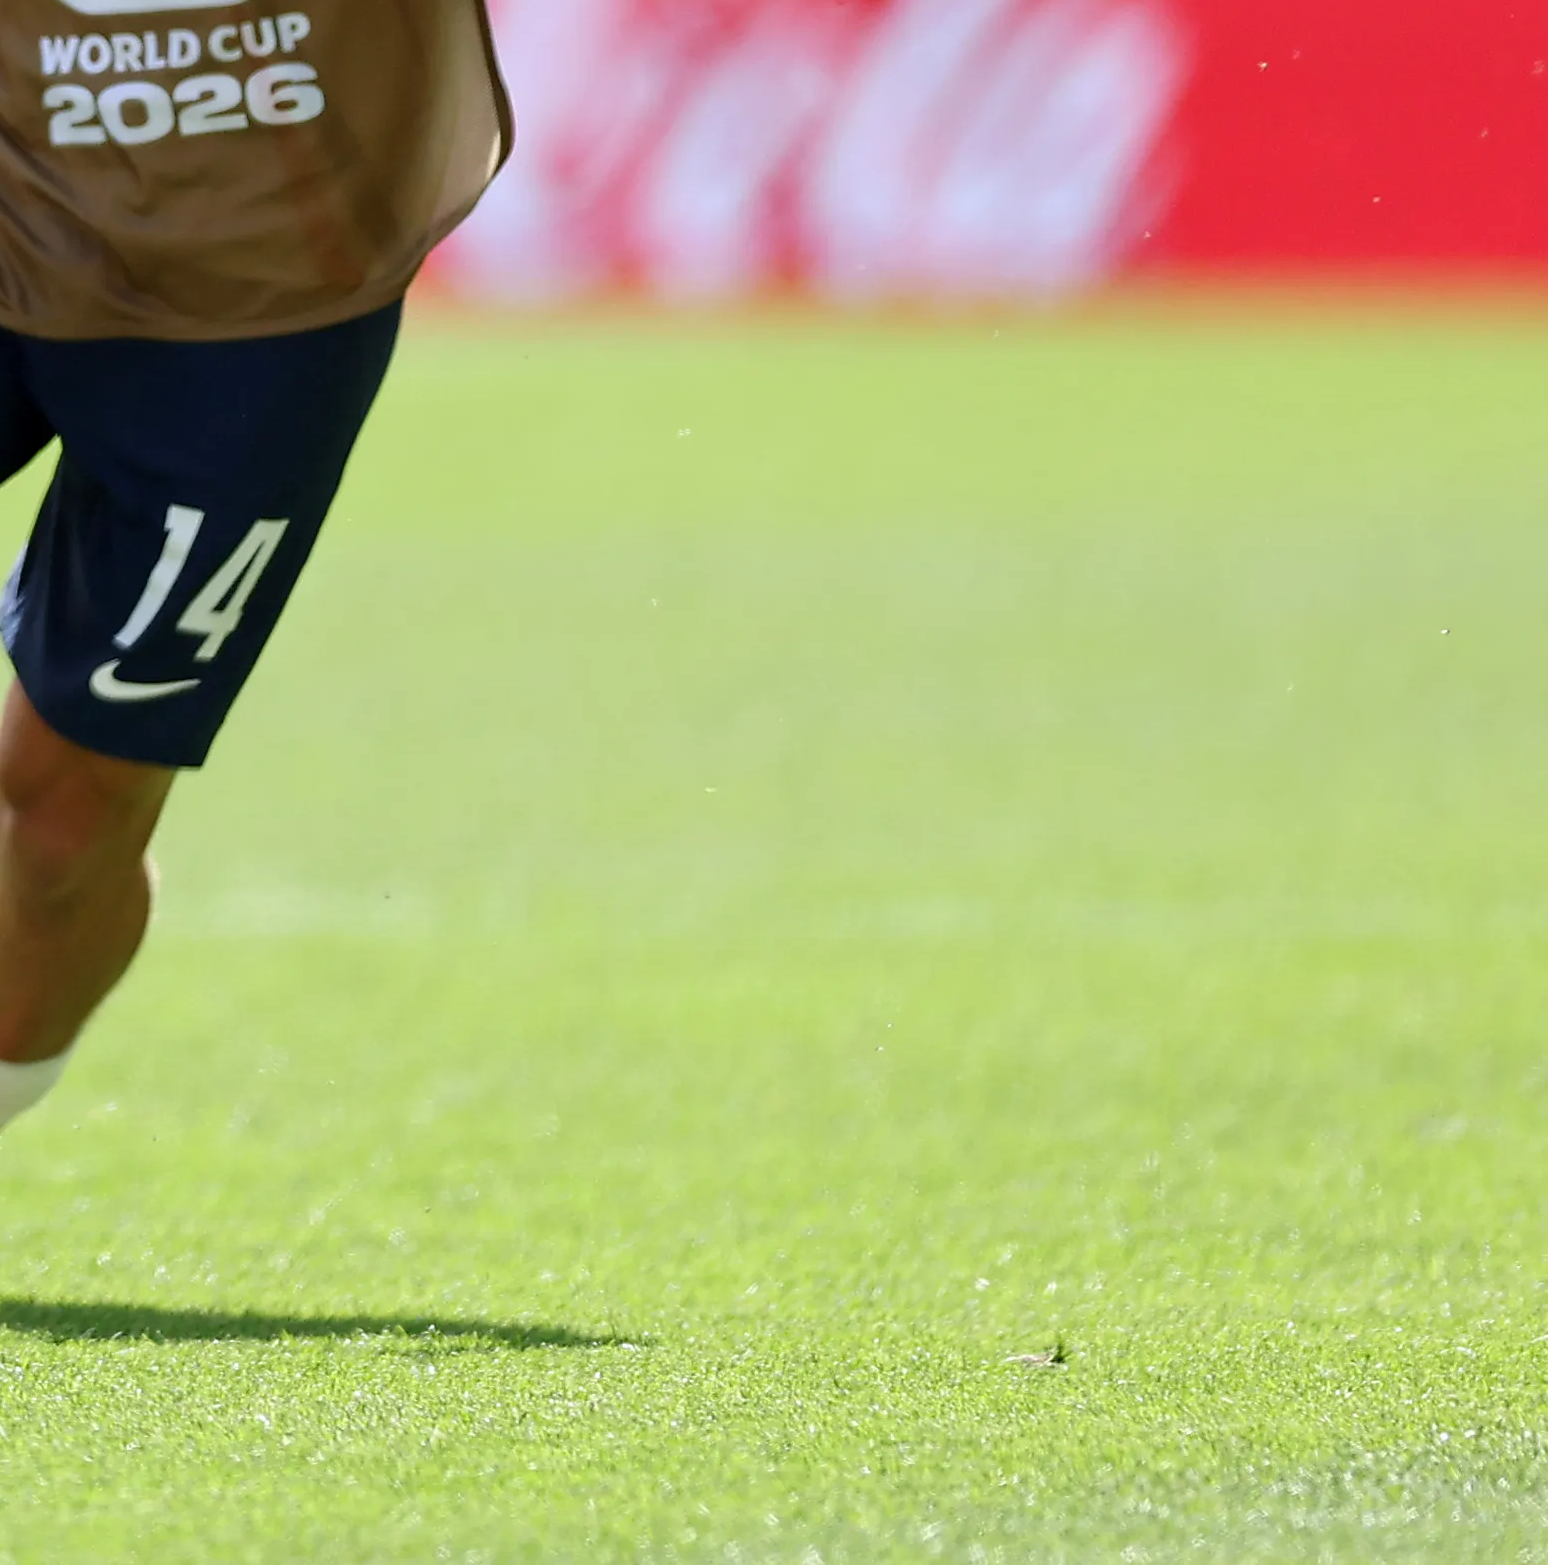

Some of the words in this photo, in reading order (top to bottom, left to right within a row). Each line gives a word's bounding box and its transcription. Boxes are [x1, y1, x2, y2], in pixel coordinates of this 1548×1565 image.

[38, 27, 201, 75] WORLD
[208, 11, 311, 63] CUP
[42, 62, 325, 147] 2026
[111, 502, 291, 663] 14
